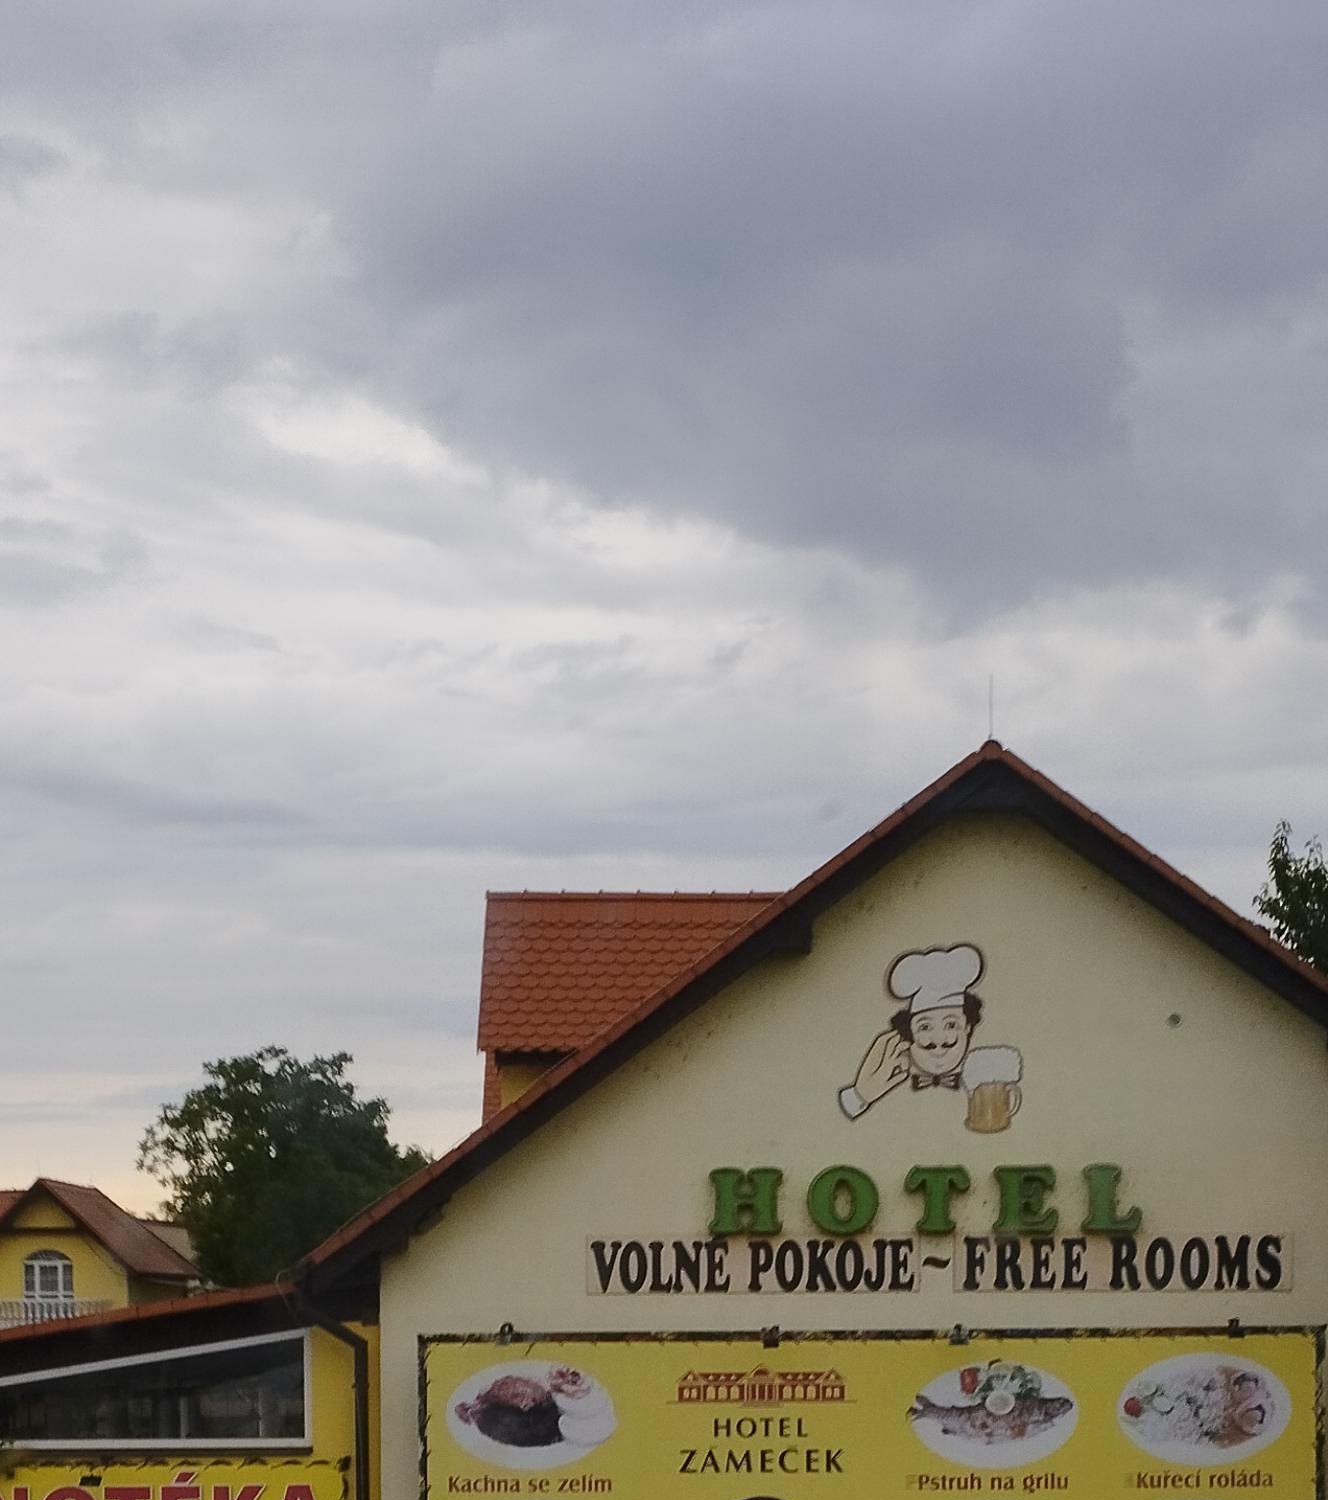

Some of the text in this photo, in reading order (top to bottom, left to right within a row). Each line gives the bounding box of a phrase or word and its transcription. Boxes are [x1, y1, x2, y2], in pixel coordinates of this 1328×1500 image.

[707, 1163, 1143, 1236] HOTEL
[748, 1238, 915, 1293] POKOJE
[961, 1236, 1089, 1292] FREE
[1109, 1235, 1283, 1292] ROOMS
[713, 1417, 809, 1439] HOTEL
[678, 1445, 846, 1475] ZÁMEČEK
[447, 1473, 613, 1494] Kachna se zelím
[918, 1472, 1069, 1494] Pstruh na grilu
[1135, 1470, 1274, 1490] Kuřecí roláda
